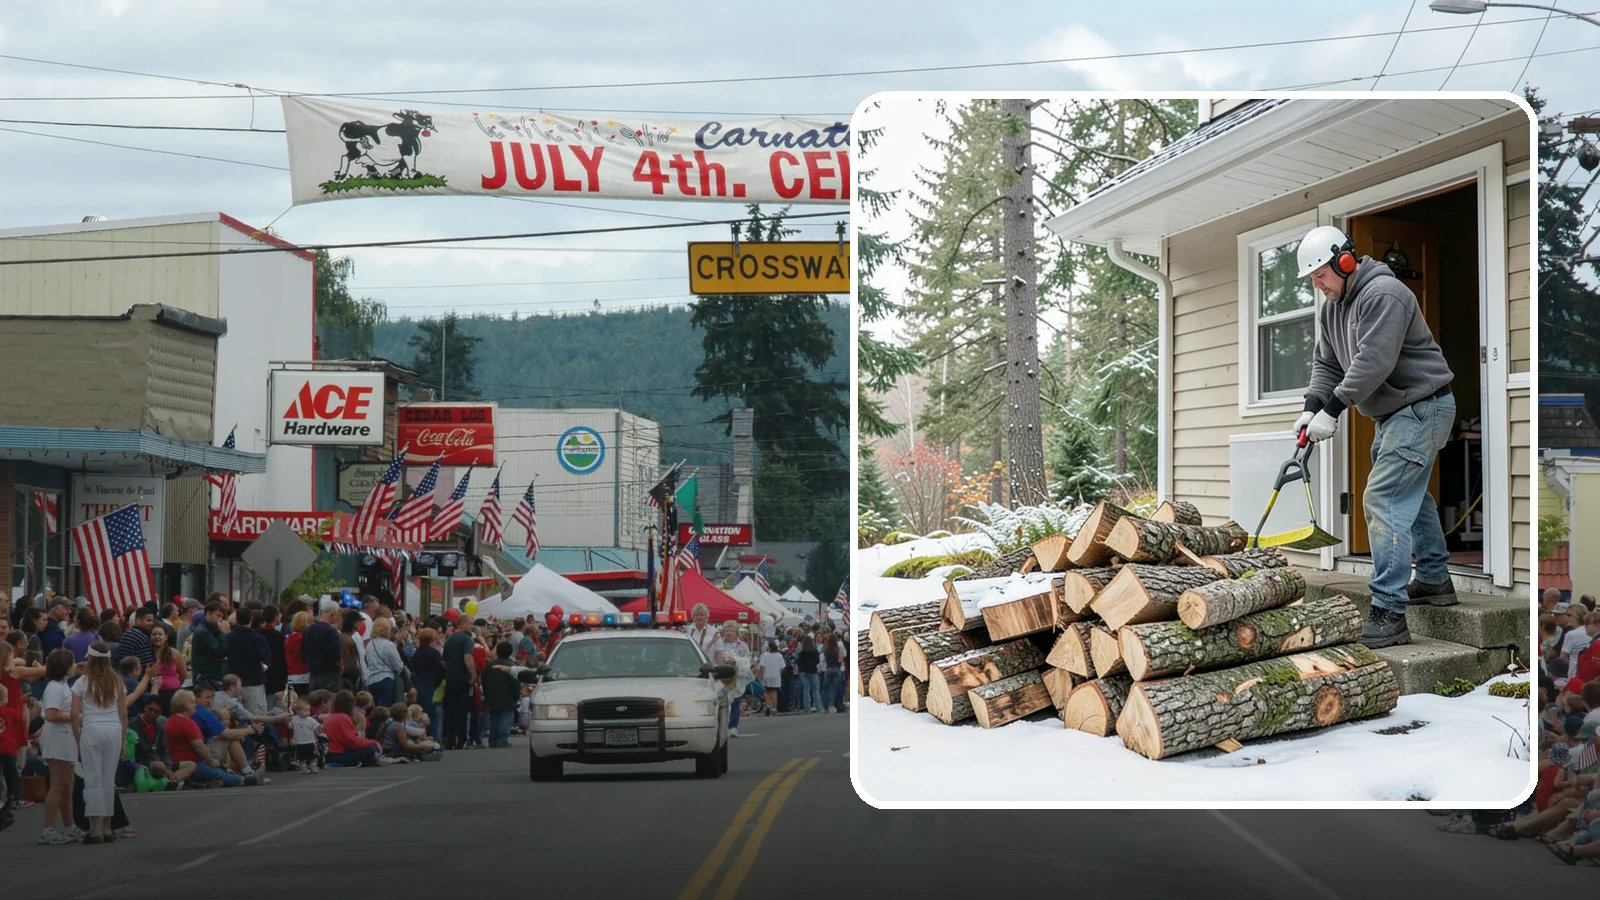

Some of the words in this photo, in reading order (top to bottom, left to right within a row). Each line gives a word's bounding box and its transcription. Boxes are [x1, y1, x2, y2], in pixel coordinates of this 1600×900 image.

[695, 120, 850, 151] Carnat
[481, 141, 605, 193] JULY
[632, 150, 747, 198] 4th.
[697, 254, 850, 280] CROSSWA
[283, 380, 373, 420] ACE
[405, 409, 452, 422] CEDAR
[461, 409, 485, 421] LOG
[283, 421, 371, 436] Hardware
[416, 428, 477, 447] Coca-Cola
[354, 467, 385, 481] Simpl
[83, 485, 93, 494] St.
[96, 485, 124, 494] Vincent
[126, 486, 136, 494] de
[138, 486, 155, 495] Paul
[688, 526, 741, 535] CRNATION
[699, 535, 730, 543] GLASS
